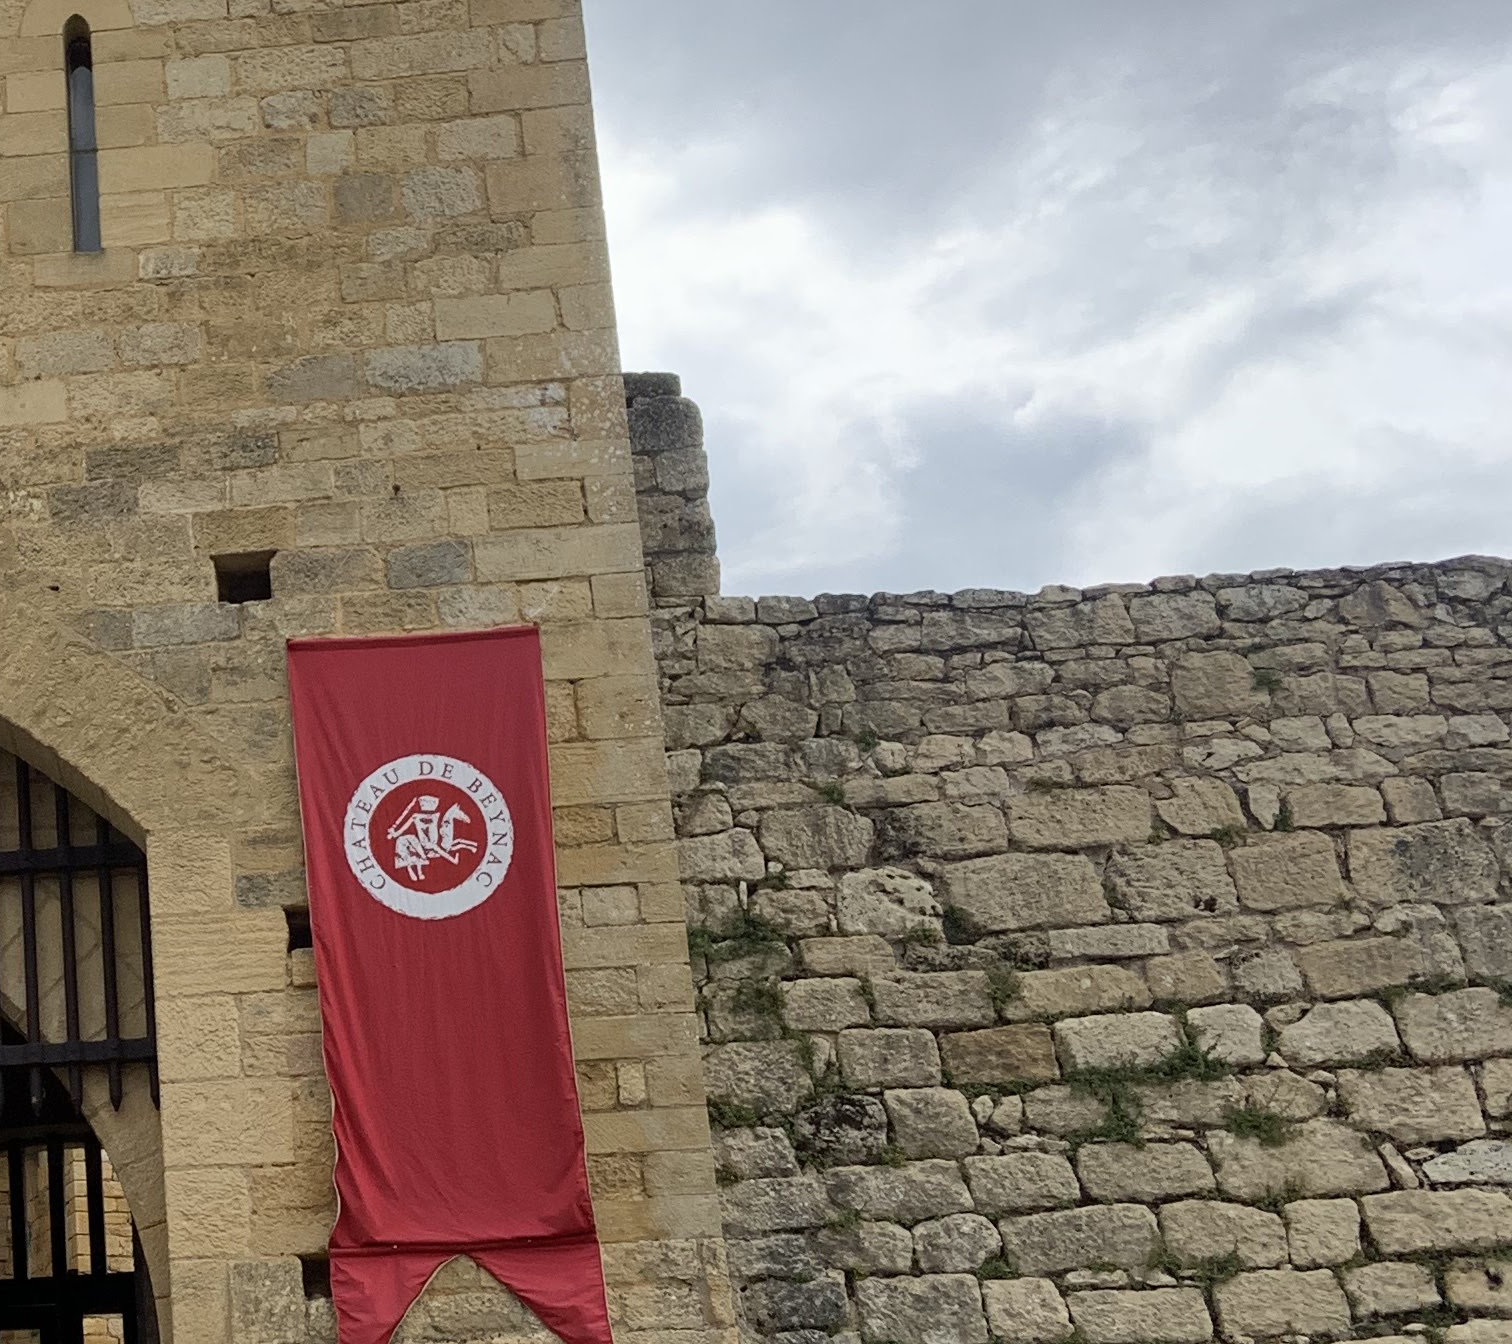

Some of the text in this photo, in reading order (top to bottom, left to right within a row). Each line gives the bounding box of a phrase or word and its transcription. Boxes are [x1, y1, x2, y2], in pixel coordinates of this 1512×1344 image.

[351, 760, 508, 890] CHATEAU DE BEYNAC
